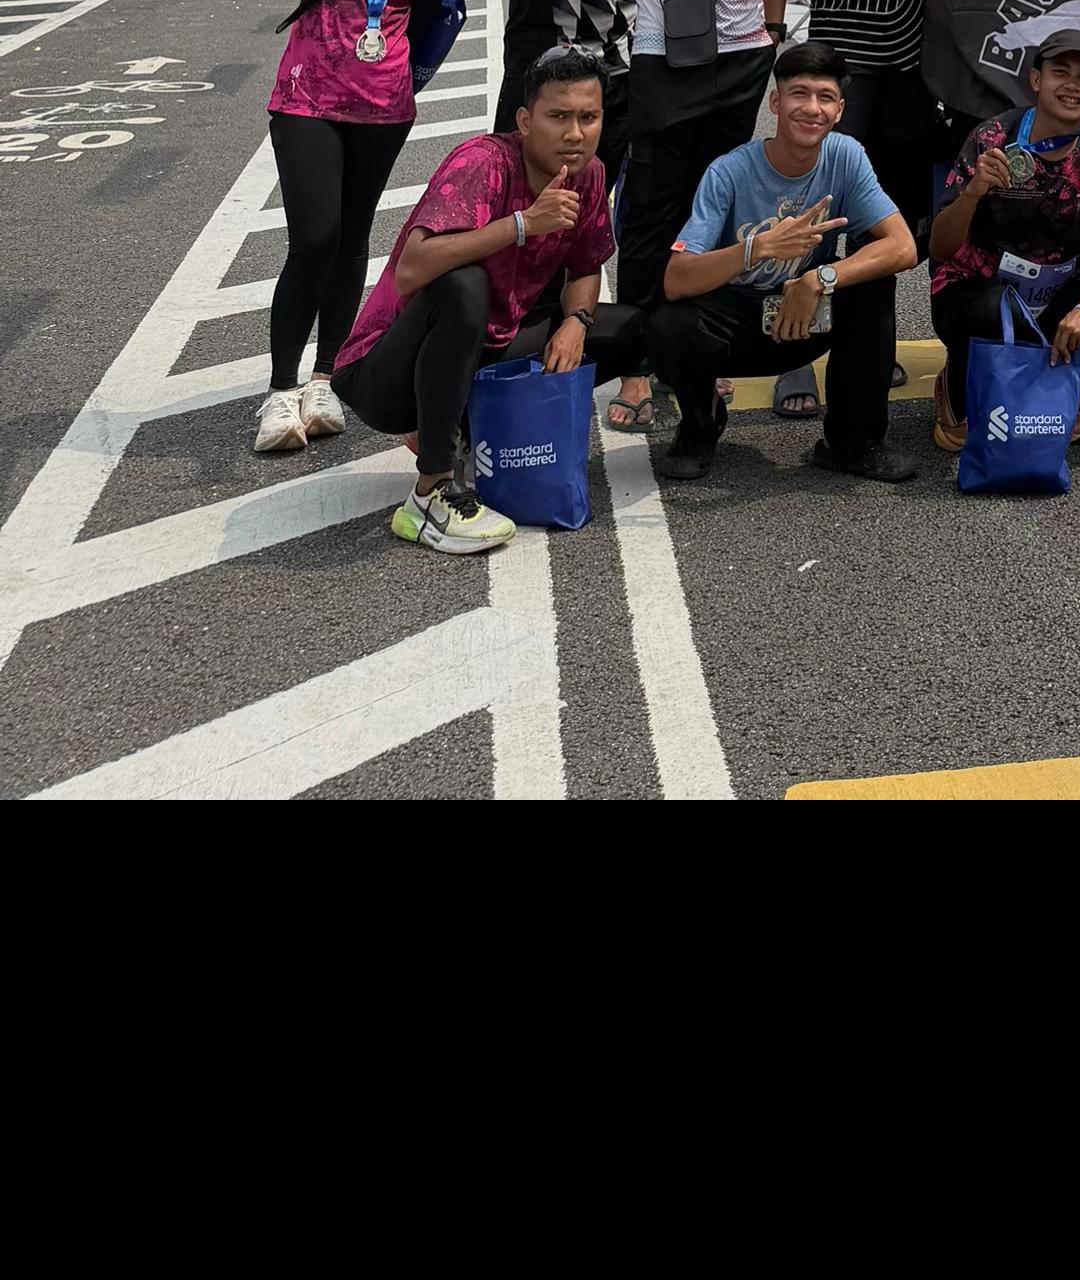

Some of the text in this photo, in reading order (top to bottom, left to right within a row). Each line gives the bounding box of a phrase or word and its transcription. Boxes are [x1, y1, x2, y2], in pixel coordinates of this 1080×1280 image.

[1014, 414, 1062, 424] standard
[1014, 424, 1066, 434] chartered
[499, 441, 553, 458] standard
[499, 452, 557, 468] chartered
